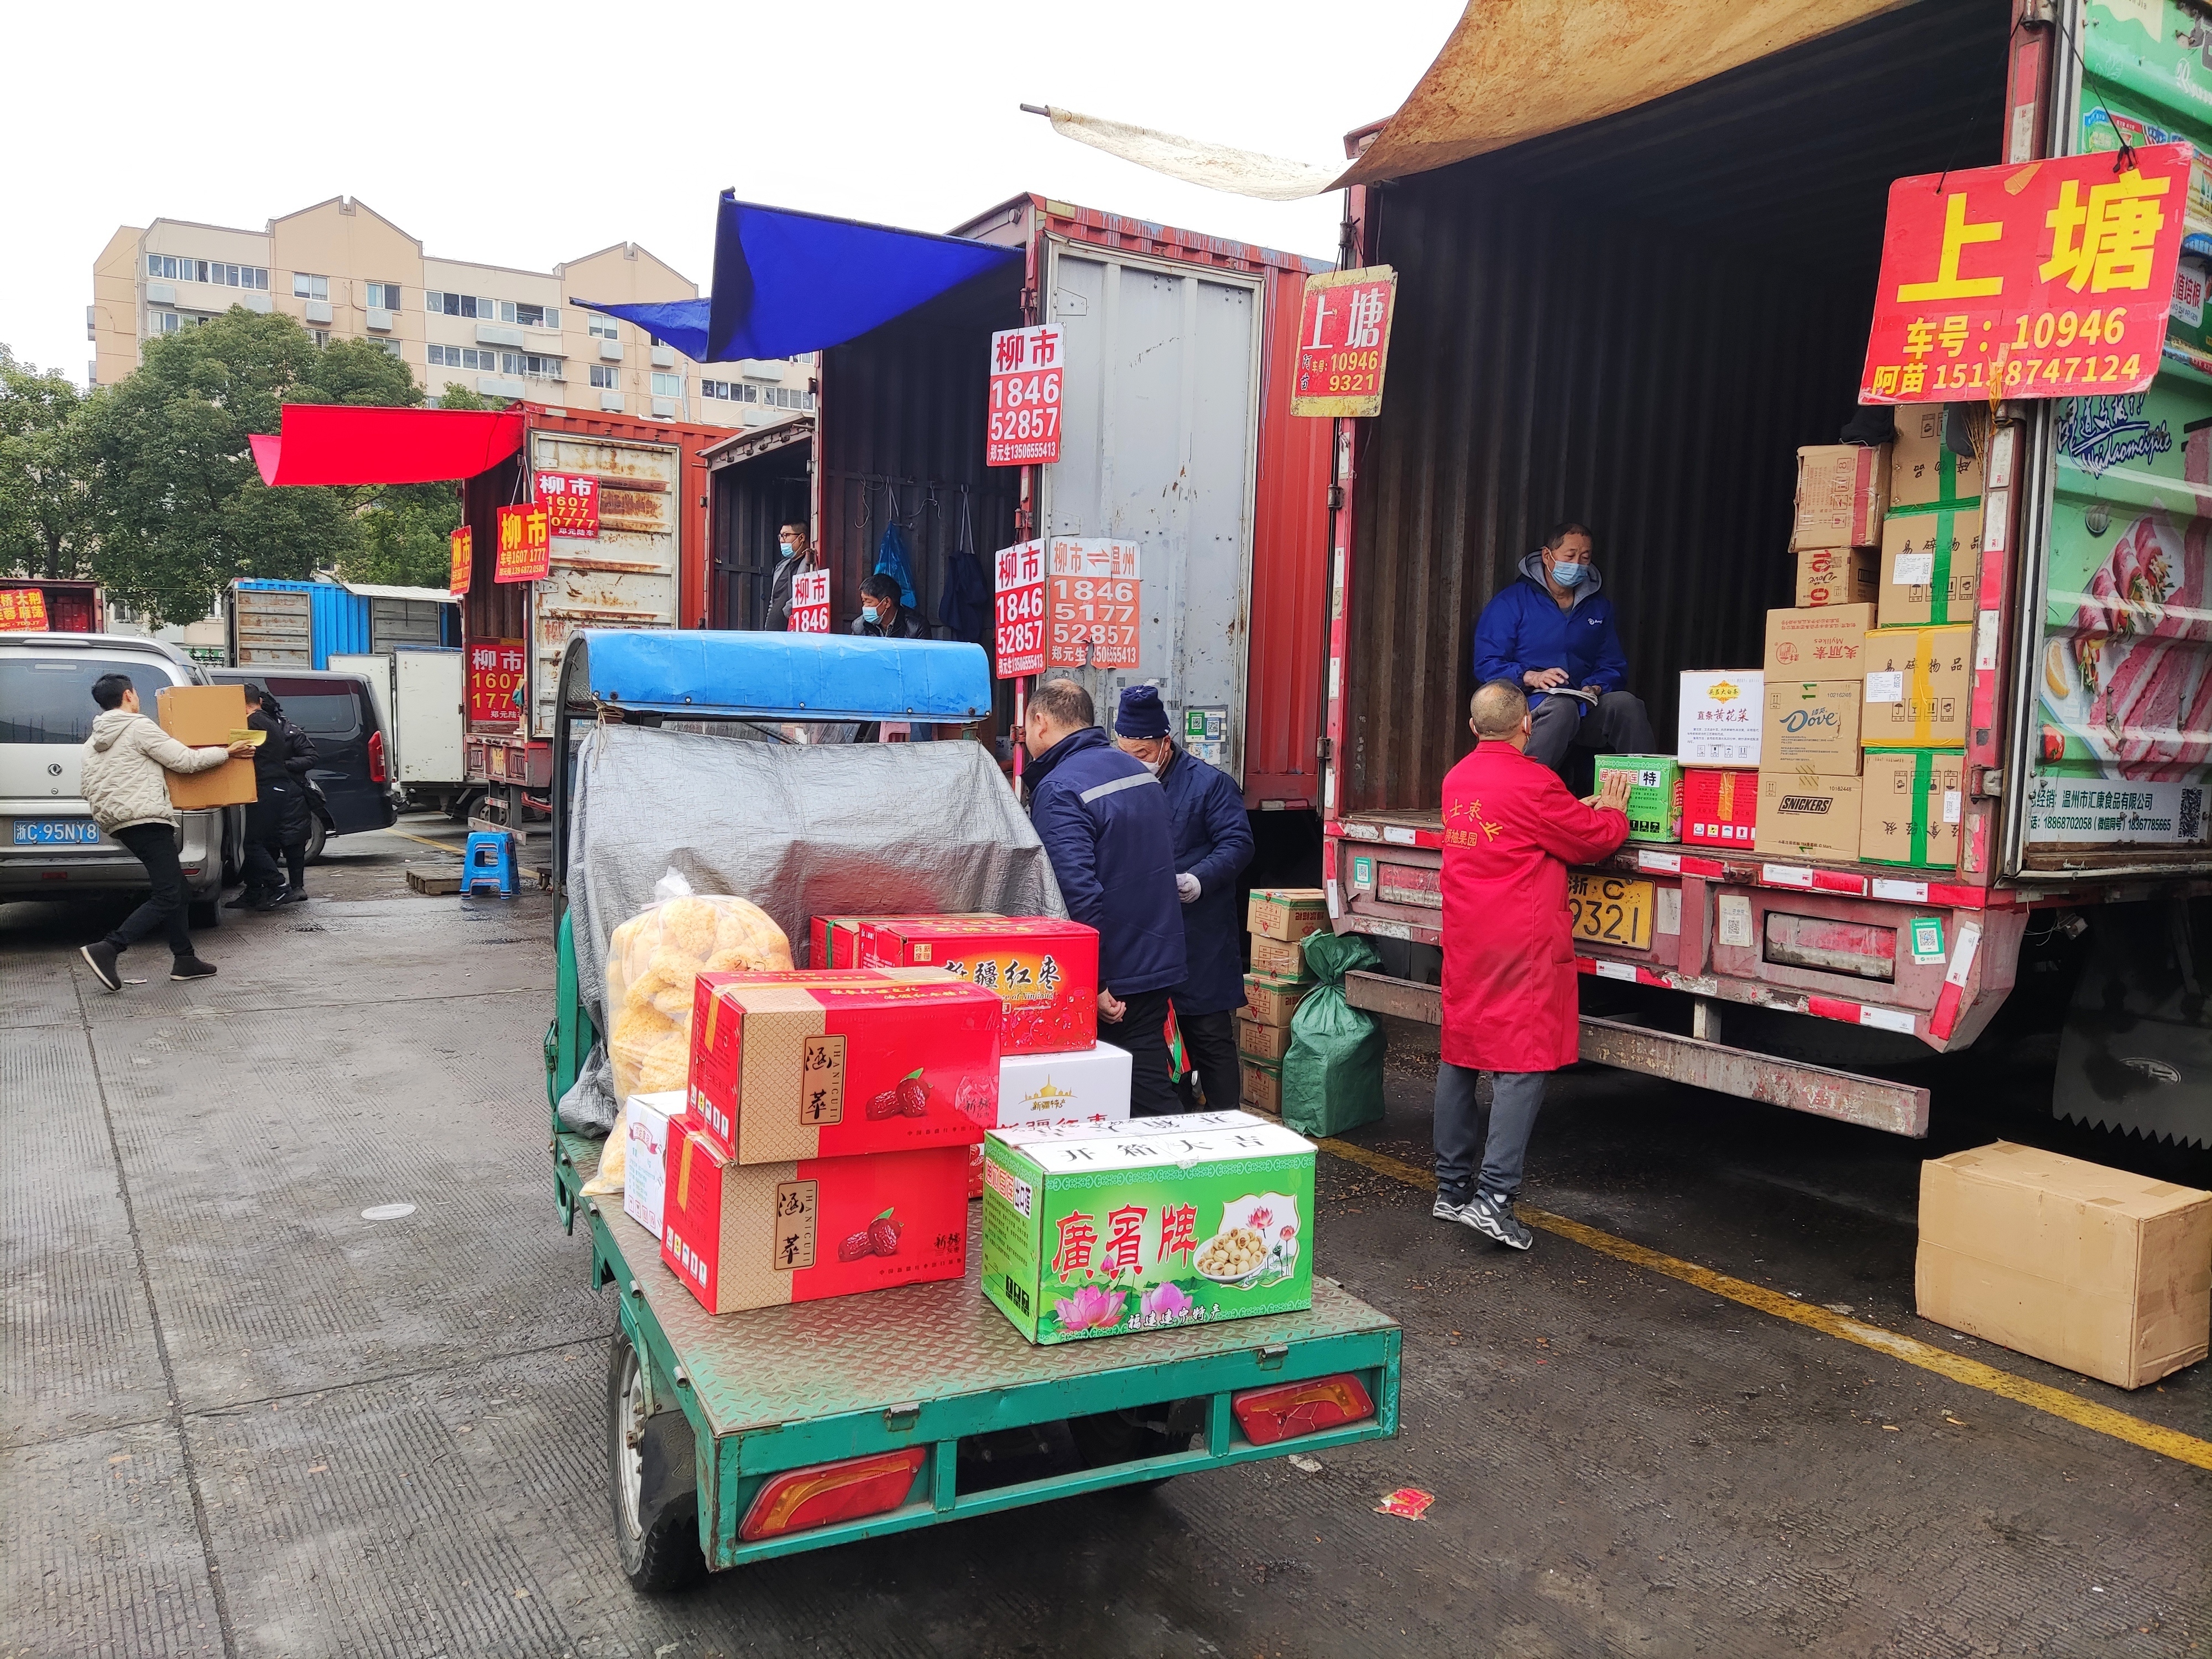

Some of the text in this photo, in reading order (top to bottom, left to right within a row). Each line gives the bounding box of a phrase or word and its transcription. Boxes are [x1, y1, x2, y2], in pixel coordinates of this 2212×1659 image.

[1896, 169, 2171, 302] 上塘
[2173, 273, 2201, 309] 值培根
[1302, 288, 1385, 349] 上塘
[996, 329, 1058, 372] 柳市
[1331, 350, 1378, 372] 10946
[1329, 374, 1374, 392] 9321
[1871, 362, 1925, 395] 阿苗
[992, 373, 1059, 408] 1846
[991, 407, 1058, 440] 52857
[990, 441, 1056, 462] 郑元生13506555413
[539, 475, 594, 497] 柳市
[546, 496, 588, 507] 1607
[502, 509, 547, 550] 柳市
[452, 532, 470, 568] 柳市
[529, 547, 546, 562] 1777
[1054, 541, 1134, 576] 柳市 温州
[999, 545, 1040, 588] 柳市
[0, 593, 13, 607] 桥
[795, 575, 826, 605] 柳市
[1054, 580, 1133, 602] 1846
[997, 587, 1042, 623] 1846
[1055, 603, 1134, 622] 5177
[793, 607, 828, 632] 1846
[998, 620, 1042, 655] 52857
[1053, 623, 1134, 645] 52857
[472, 649, 523, 671] 柳市
[1052, 645, 1136, 662] 郑元生3506555413
[1813, 645, 1859, 659] 麦丽素
[472, 672, 523, 690] 1607
[472, 693, 520, 709] 177
[1780, 710, 1838, 733] Dove
[1643, 771, 1656, 785] 特
[1782, 798, 1829, 812] SNICKERS
[1058, 1135, 1265, 1162] 开箱大吉
[1126, 1303, 1221, 1330] 福建建宁特产
